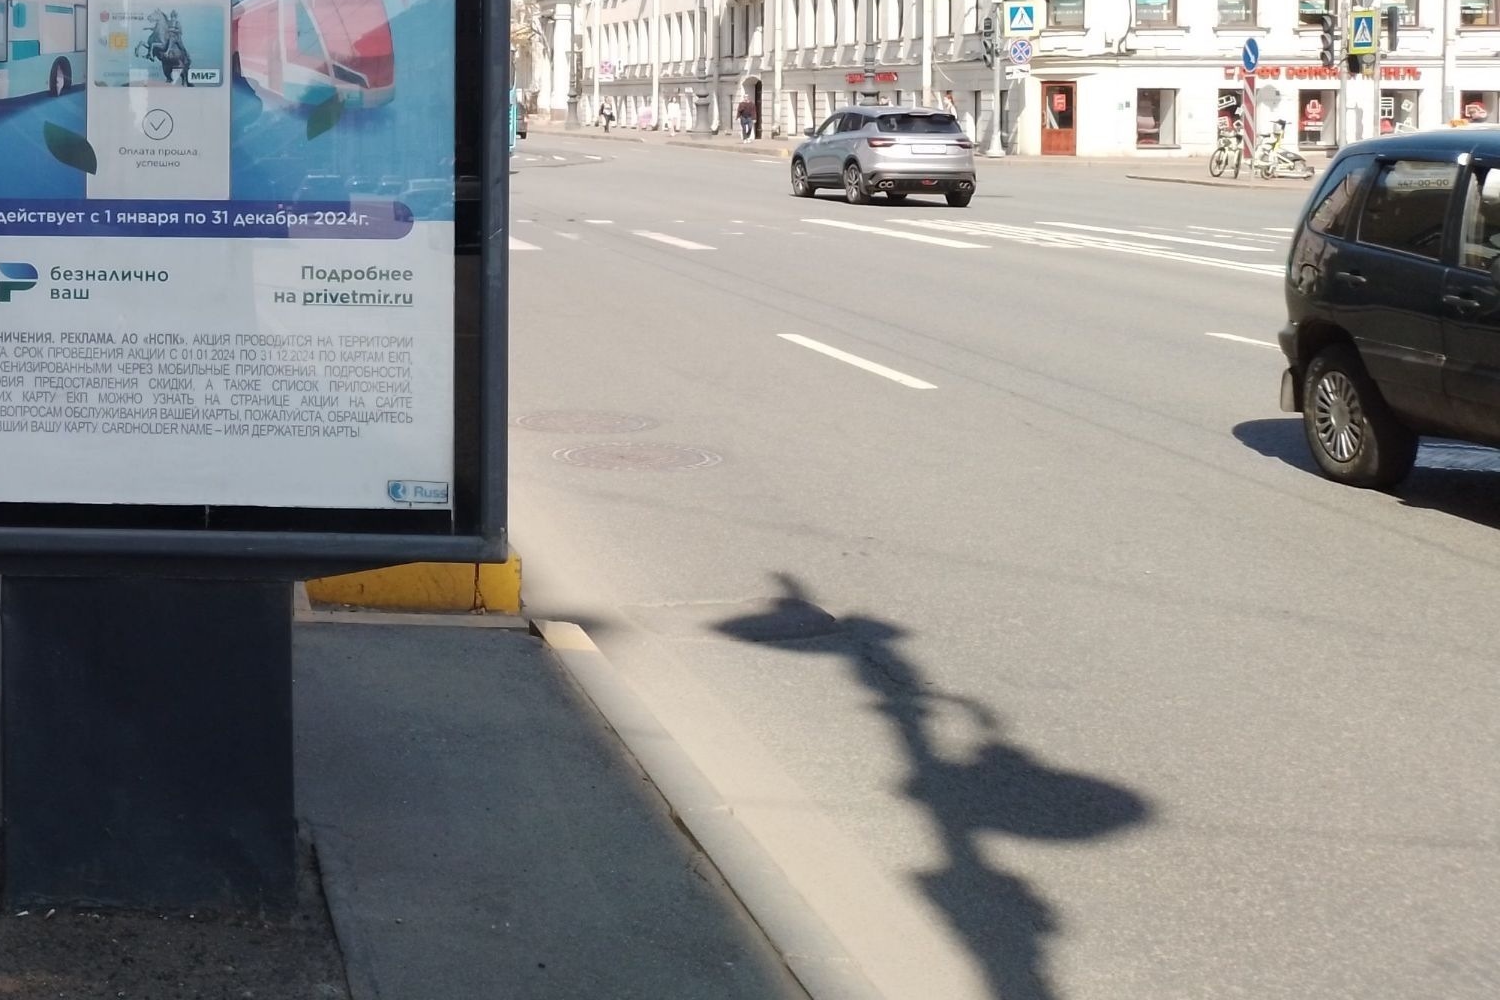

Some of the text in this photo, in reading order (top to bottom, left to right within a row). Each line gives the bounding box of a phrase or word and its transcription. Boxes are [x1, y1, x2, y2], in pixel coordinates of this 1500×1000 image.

[191, 72, 216, 80] МИР
[119, 146, 199, 158] Оплата прошла
[136, 158, 181, 169] успешно
[91, 213, 100, 224] с
[104, 211, 110, 224] 1
[115, 213, 179, 226] января
[184, 214, 206, 226] по
[211, 211, 228, 226] 31
[233, 211, 310, 227] декабря
[314, 212, 370, 226] 2024г.
[51, 266, 169, 283] безналично
[301, 265, 413, 284] Подробнее
[50, 289, 90, 300] ваш
[273, 289, 414, 307] на privetmir.ru
[121, 333, 138, 344] АО
[193, 334, 231, 347] АКЦИЯ
[235, 335, 312, 348] ПРОВОДИТСЯ
[317, 336, 333, 347] НА
[338, 336, 414, 348] ТЕРРИТОРИИ
[13, 347, 43, 359] СРОК
[48, 347, 123, 360] ПРОВЕДЕНИЯ
[127, 348, 165, 361] АКЦИИ
[169, 349, 178, 360] С
[181, 349, 235, 361] 01.01.2024
[240, 350, 257, 361] ПО
[319, 350, 336, 362] ПО
[340, 351, 384, 362] КАРТАМ
[117, 362, 153, 374] ЧЕРЕЗ
[158, 363, 230, 376] МОБИЛЬНЫЕ
[34, 376, 138, 390] ПРЕДОСТАВЛЕНИЯ
[205, 379, 214, 391] А
[224, 379, 262, 391] ТАКЖЕ
[271, 380, 319, 392] СПИСОК
[22, 391, 56, 403] КАРТУ
[66, 391, 89, 403] ЕКП
[98, 392, 143, 404] МОЖНО
[153, 393, 195, 405] УЗНАТЬ
[204, 394, 220, 406] НА
[230, 394, 290, 407] СТРАНИЦЕ
[300, 395, 339, 409] АКЦИИ
[349, 396, 365, 408] НА
[375, 393, 413, 409] САЙТЕ
[0, 406, 62, 418] ВОПРОСАМ
[64, 407, 158, 420] ОБСЛУЖИВАНИЯ
[160, 406, 200, 420] ВАШЕЙ
[328, 408, 413, 425] ОБРАЩАЙТЕСЬ
[31, 420, 62, 432] ВАШУ
[101, 422, 179, 435] CARDHOLDER
[181, 424, 212, 435] NAME
[224, 425, 249, 436] ИМЯ
[251, 425, 319, 438] ДЕРЖАТЕЛЯ
[414, 486, 447, 499] Russ
